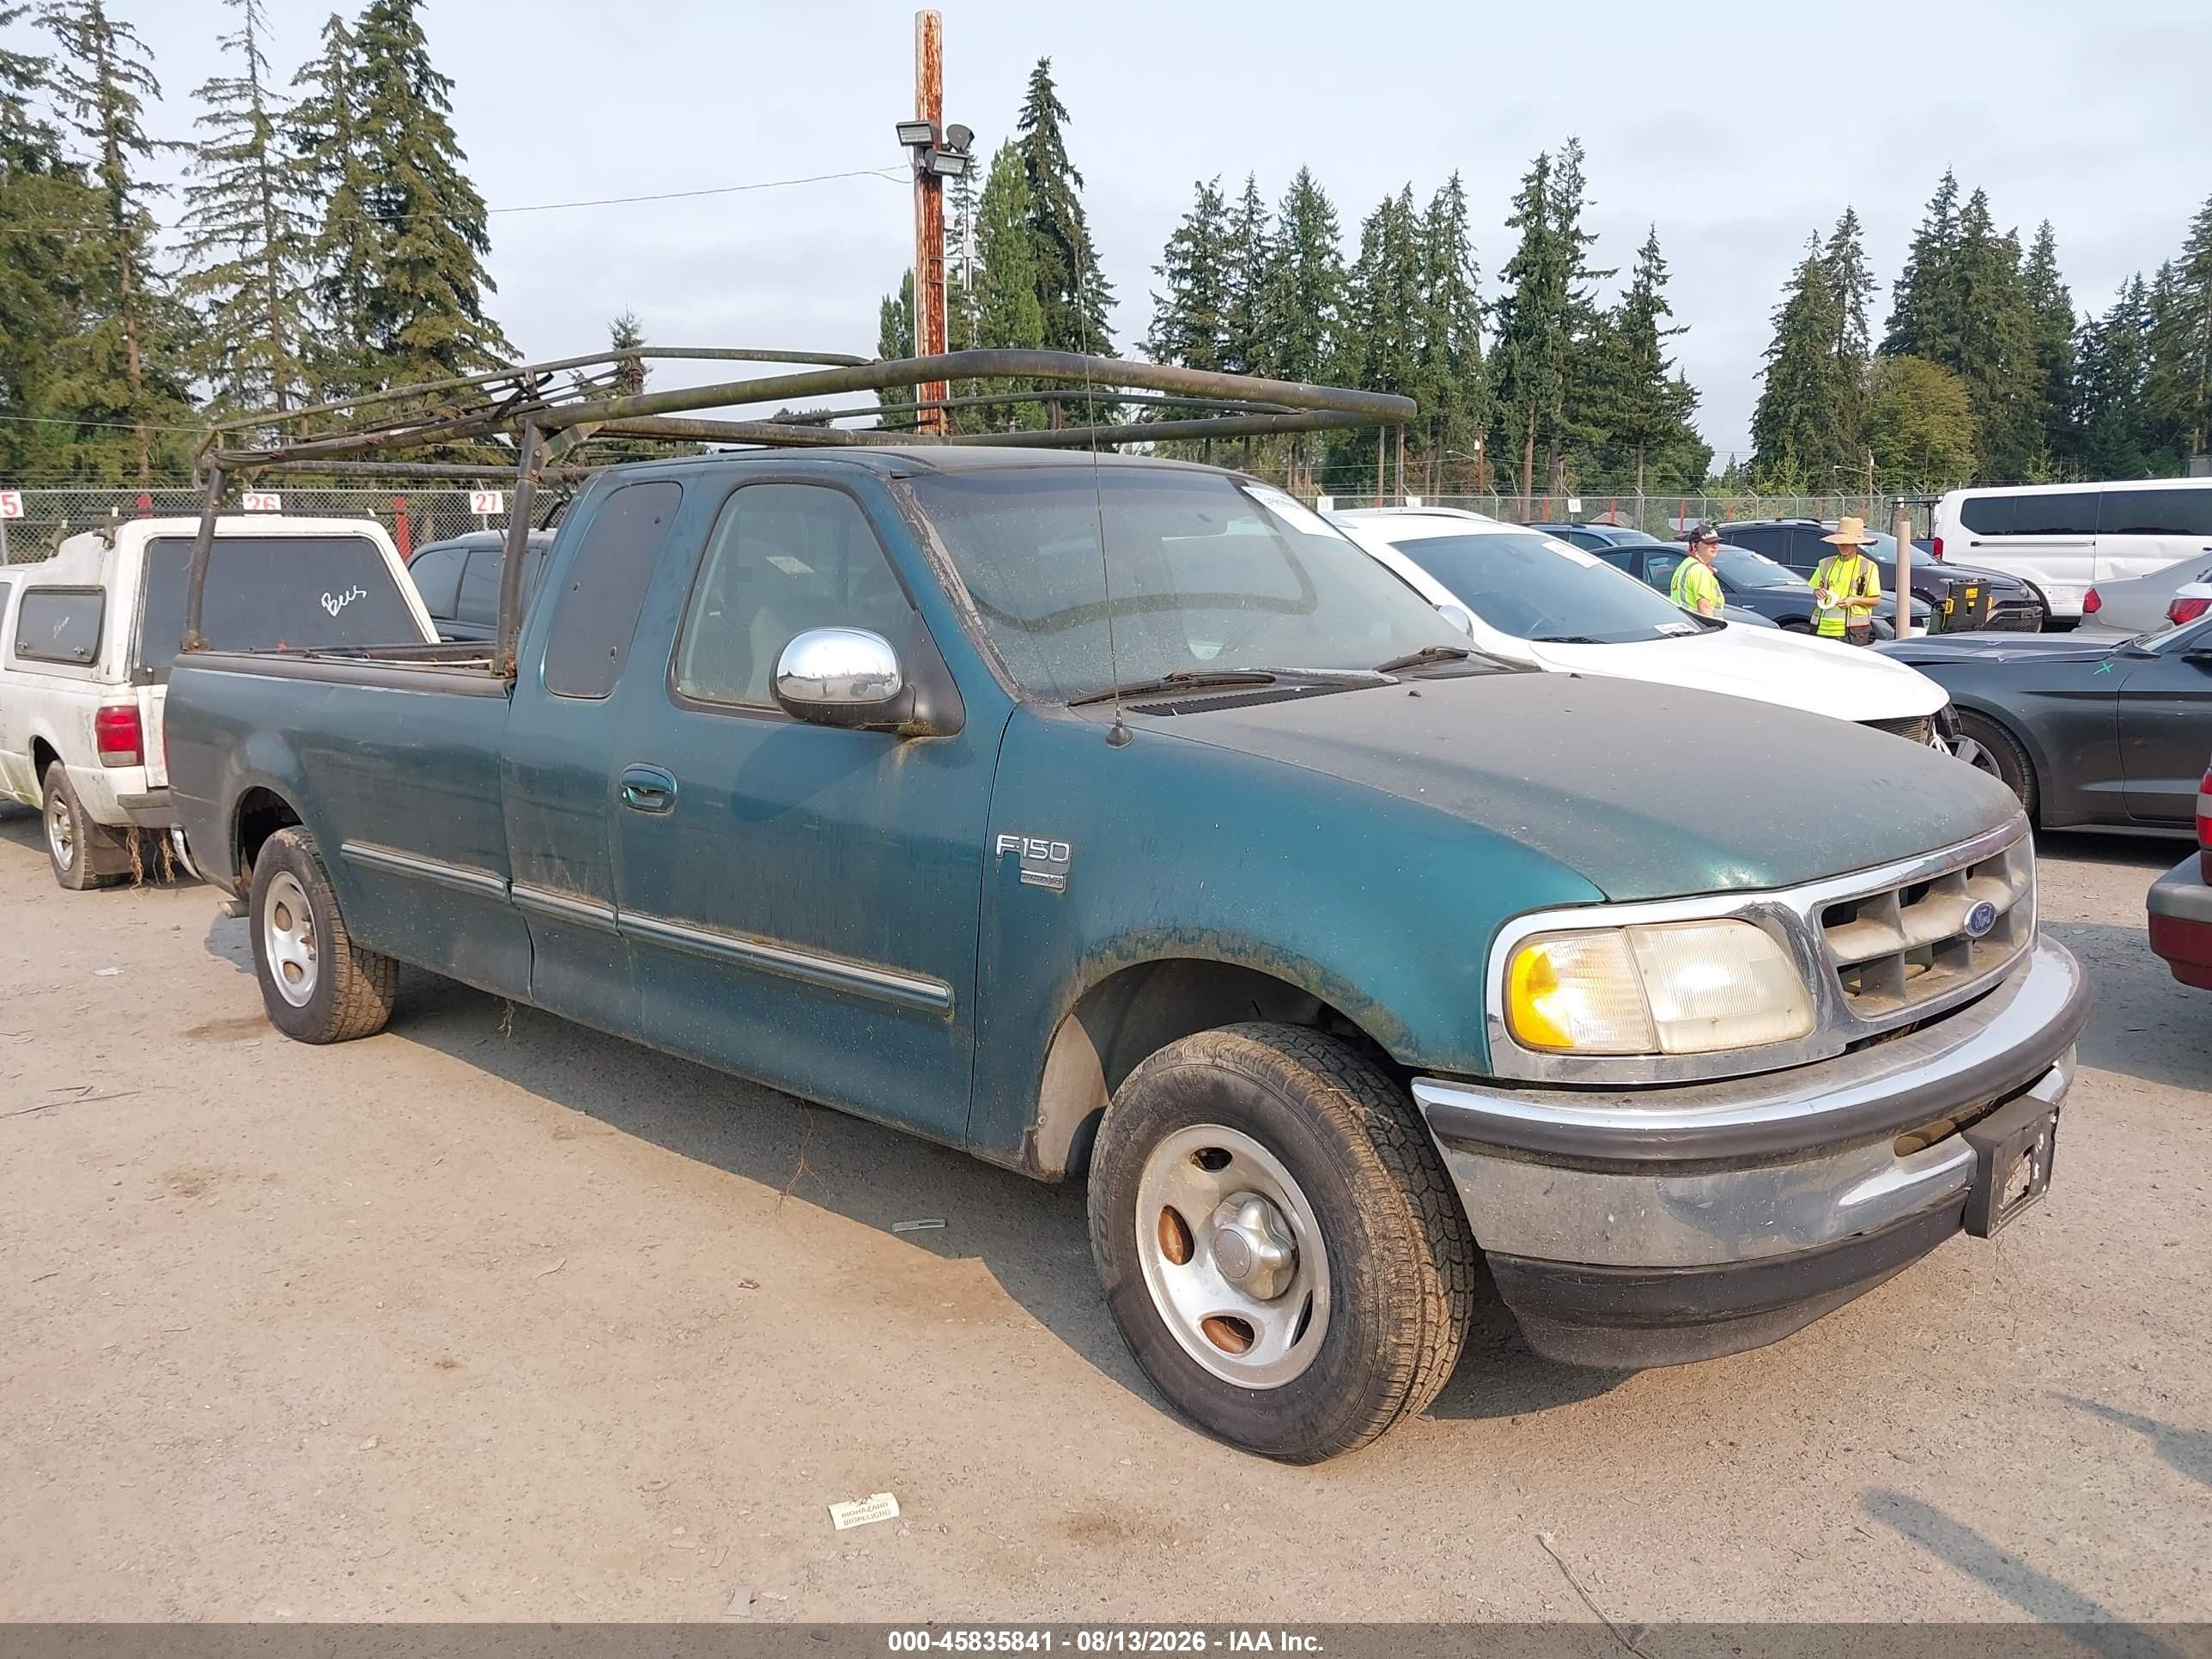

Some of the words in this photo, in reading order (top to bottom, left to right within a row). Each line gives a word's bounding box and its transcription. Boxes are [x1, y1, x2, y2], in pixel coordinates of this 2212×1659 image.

[476, 493, 496, 512] 27
[1974, 905, 1994, 929] Ford
[841, 1501, 889, 1518] BIOHAZARD
[842, 1509, 892, 1526] BIOPELIGRO
